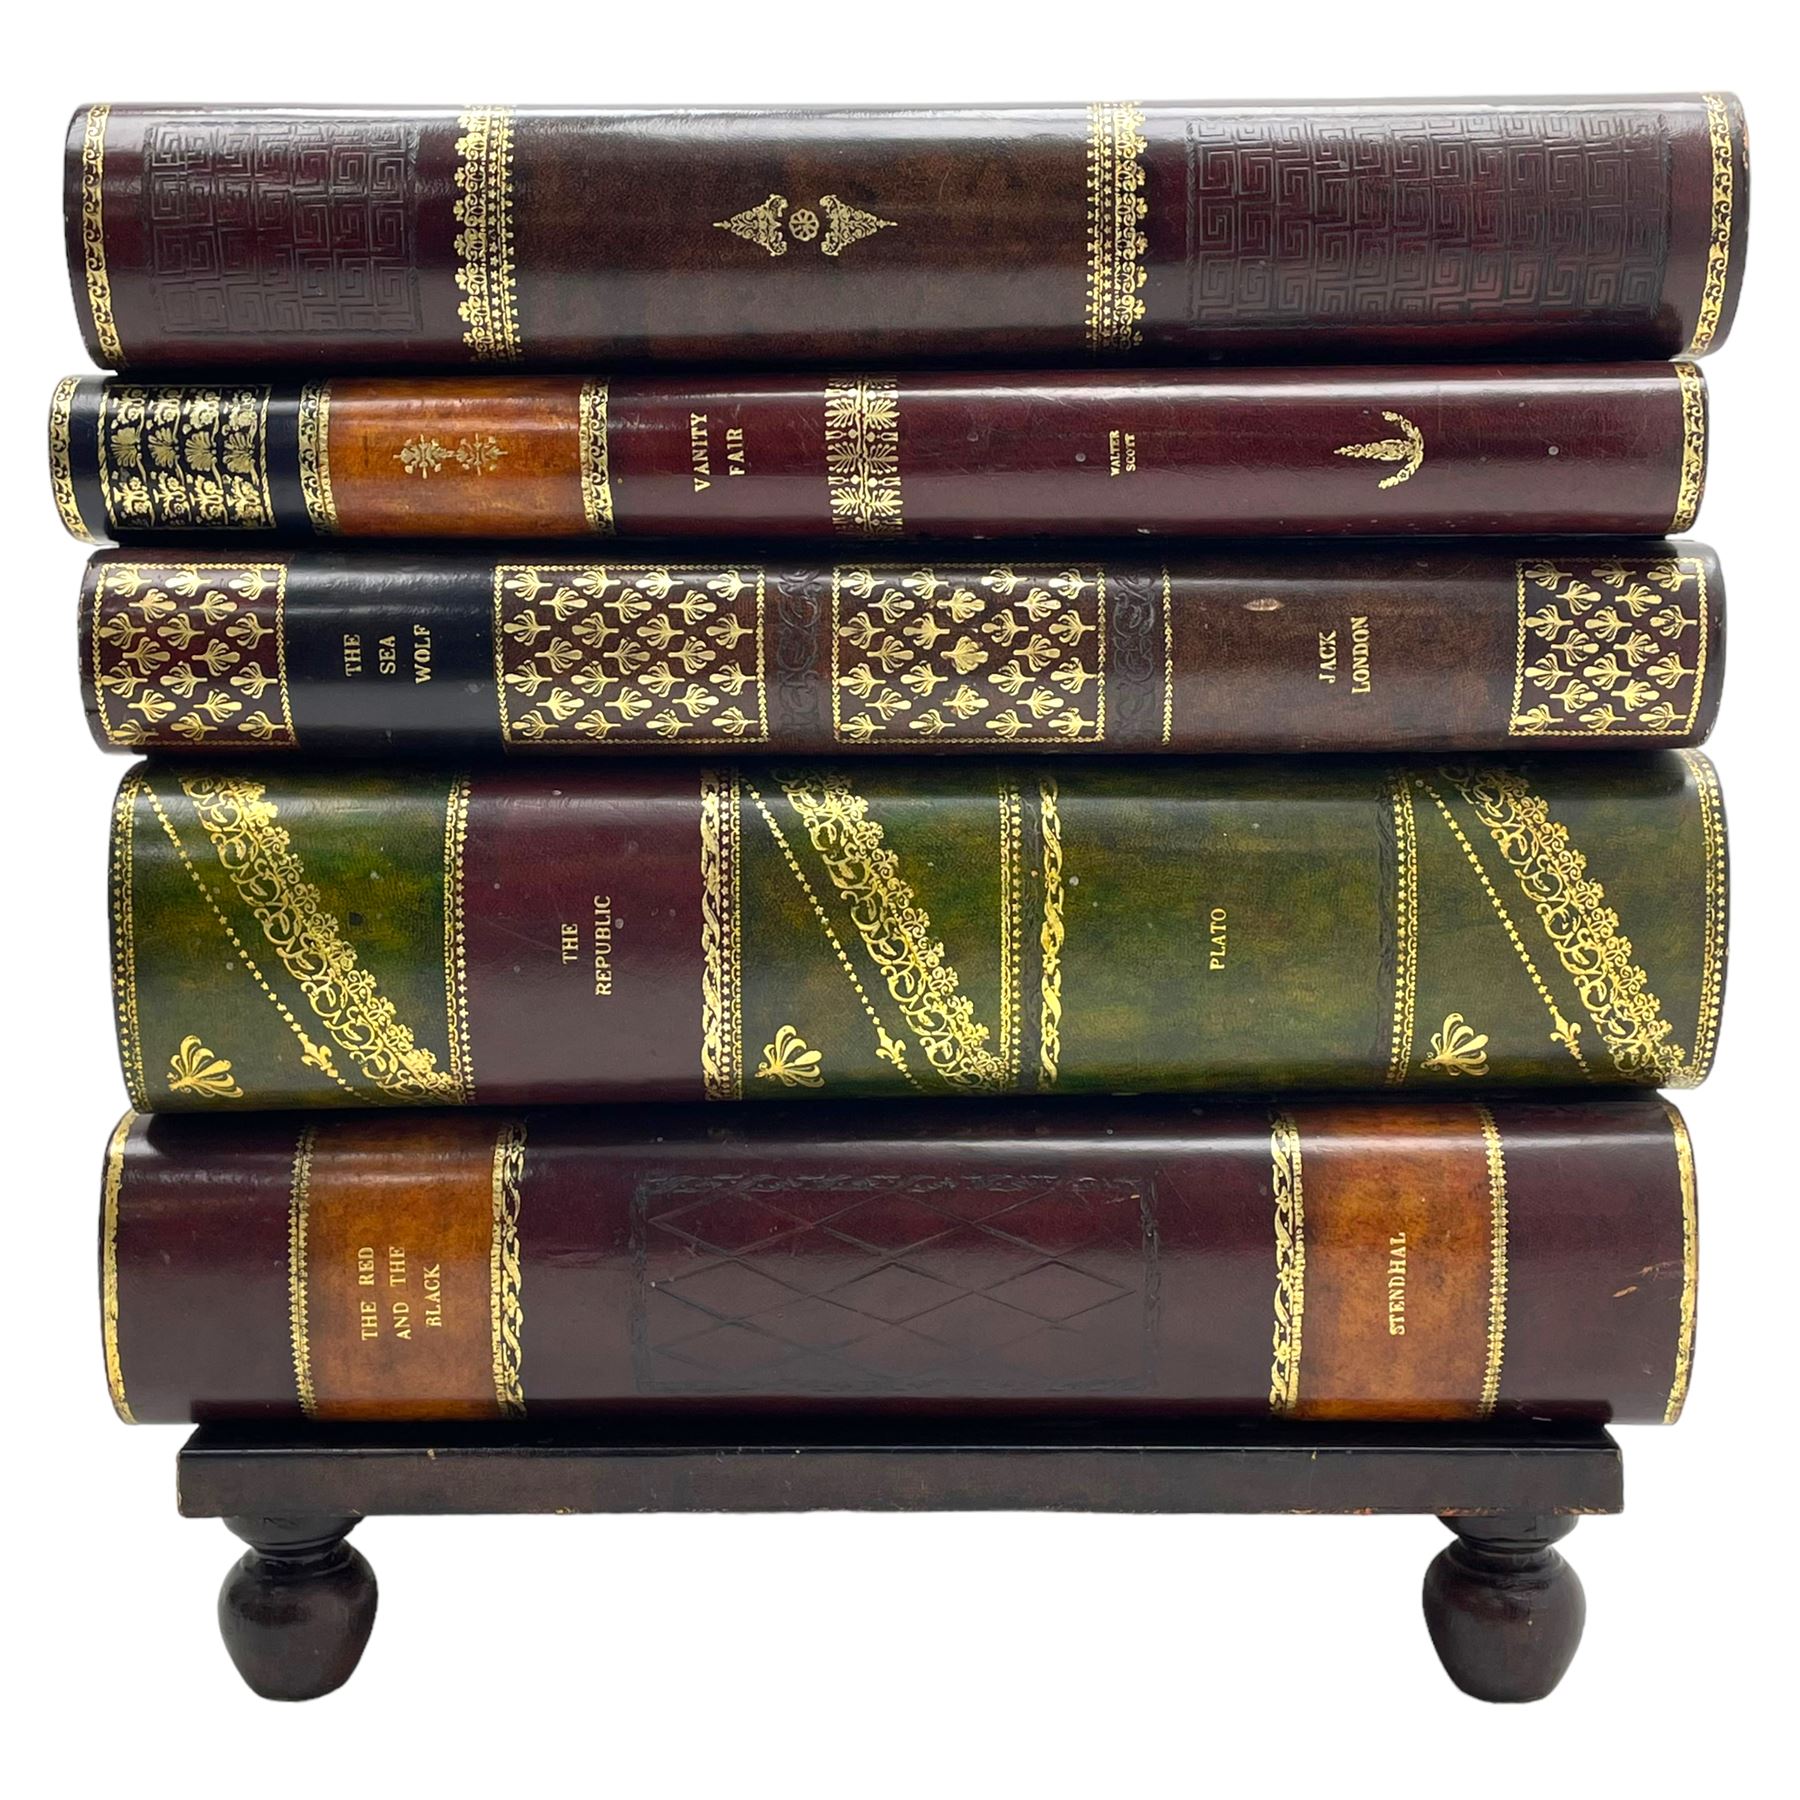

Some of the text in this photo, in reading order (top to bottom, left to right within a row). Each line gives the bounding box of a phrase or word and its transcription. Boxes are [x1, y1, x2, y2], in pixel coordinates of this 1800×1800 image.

[691, 412, 710, 493] VANITY
[725, 429, 744, 476] FAIR
[1109, 430, 1121, 477] WALTER
[1124, 433, 1137, 472] SCOTT
[343, 634, 362, 677] THE
[378, 636, 396, 675] SEA
[414, 625, 432, 684] WOLF
[1318, 630, 1337, 684] JACK
[1350, 616, 1371, 694] LONDON
[562, 923, 579, 965] THE
[593, 895, 612, 996] REPUBLIC
[1209, 908, 1227, 970] PLATO
[358, 1247, 378, 1341] THE RED
[390, 1247, 411, 1340] AND THE
[423, 1263, 442, 1327] BLACK
[1388, 1232, 1407, 1336] STENDHAL
